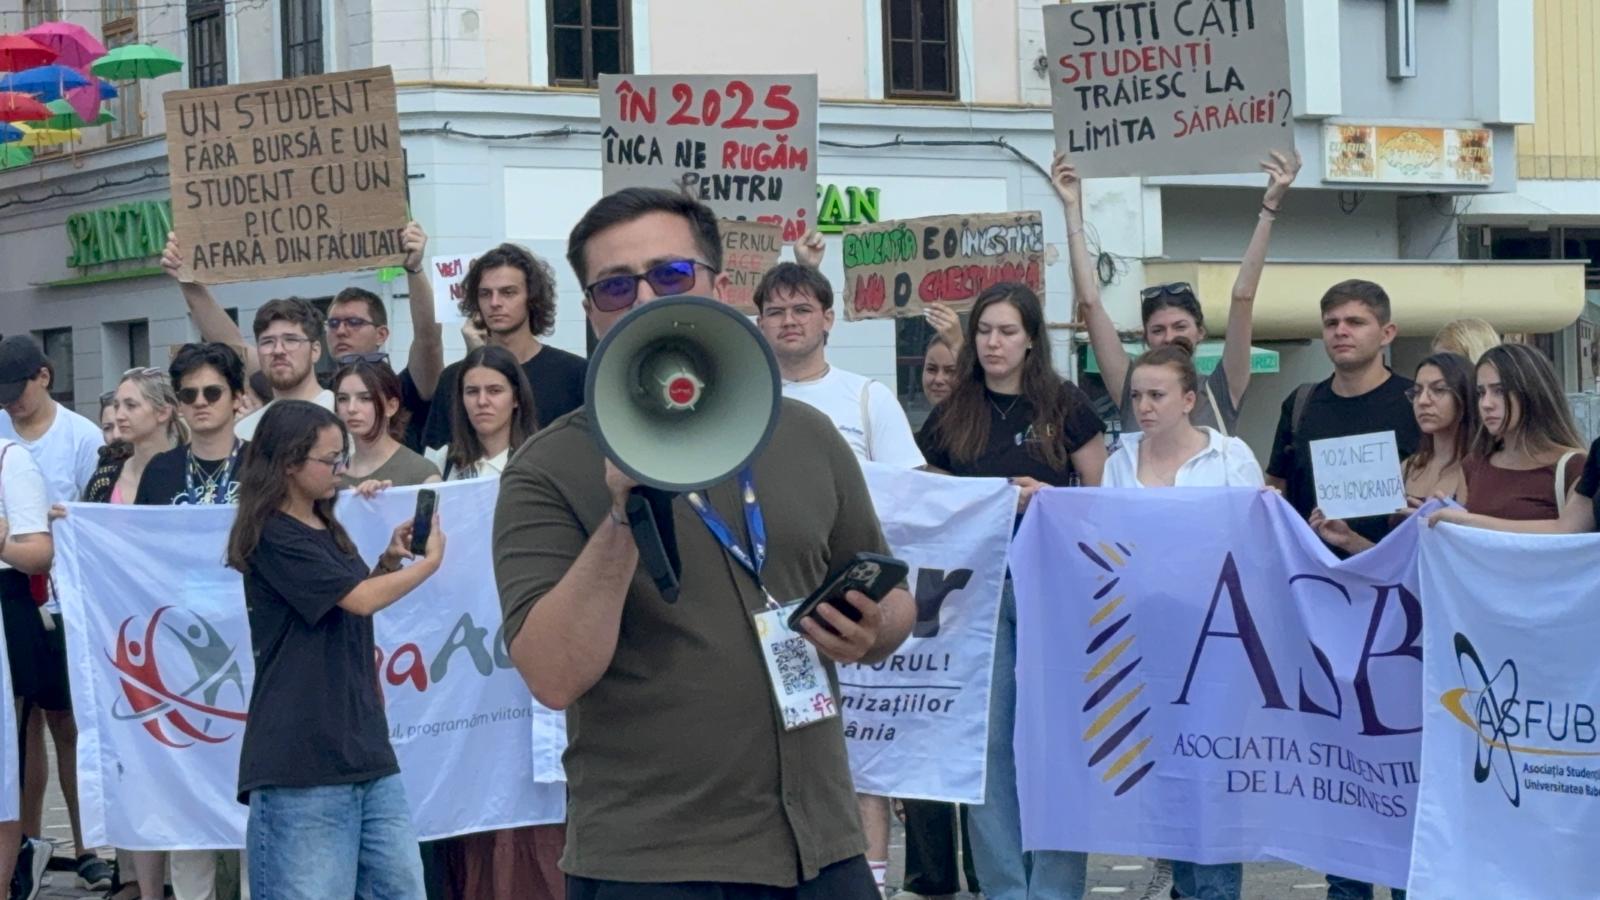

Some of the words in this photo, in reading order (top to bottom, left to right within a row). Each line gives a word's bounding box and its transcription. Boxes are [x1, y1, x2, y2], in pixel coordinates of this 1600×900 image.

[1059, 38, 1212, 84] STUDENȚI
[1205, 66, 1245, 94] LA
[180, 101, 221, 138] UN
[234, 79, 373, 129] STUDENT
[615, 80, 657, 124] ÎN
[666, 80, 800, 131] 2025
[184, 136, 239, 173] FĂRĂ
[253, 125, 323, 165] BURSĂ
[331, 128, 345, 154] E
[353, 123, 389, 153] UN
[602, 126, 664, 166] ÎNCA
[675, 138, 707, 169] NE
[721, 134, 808, 171] RUGĂM
[185, 168, 295, 209] STUDENT
[311, 164, 345, 196] CU
[354, 160, 391, 192] UN
[681, 171, 783, 203] PENTRU
[817, 184, 881, 224] AN
[245, 203, 332, 238] PICIOR
[193, 234, 266, 271] AFARĂ
[276, 235, 312, 264] DIN
[923, 226, 941, 261] E
[943, 227, 958, 258] O
[893, 272, 912, 307] O
[1350, 441, 1391, 465] NET
[1170, 551, 1423, 736] ASB
[407, 712, 489, 738] programăm
[1226, 770, 1268, 793] DE
[1274, 771, 1305, 799] LA
[1312, 776, 1408, 818] BUSINESS
